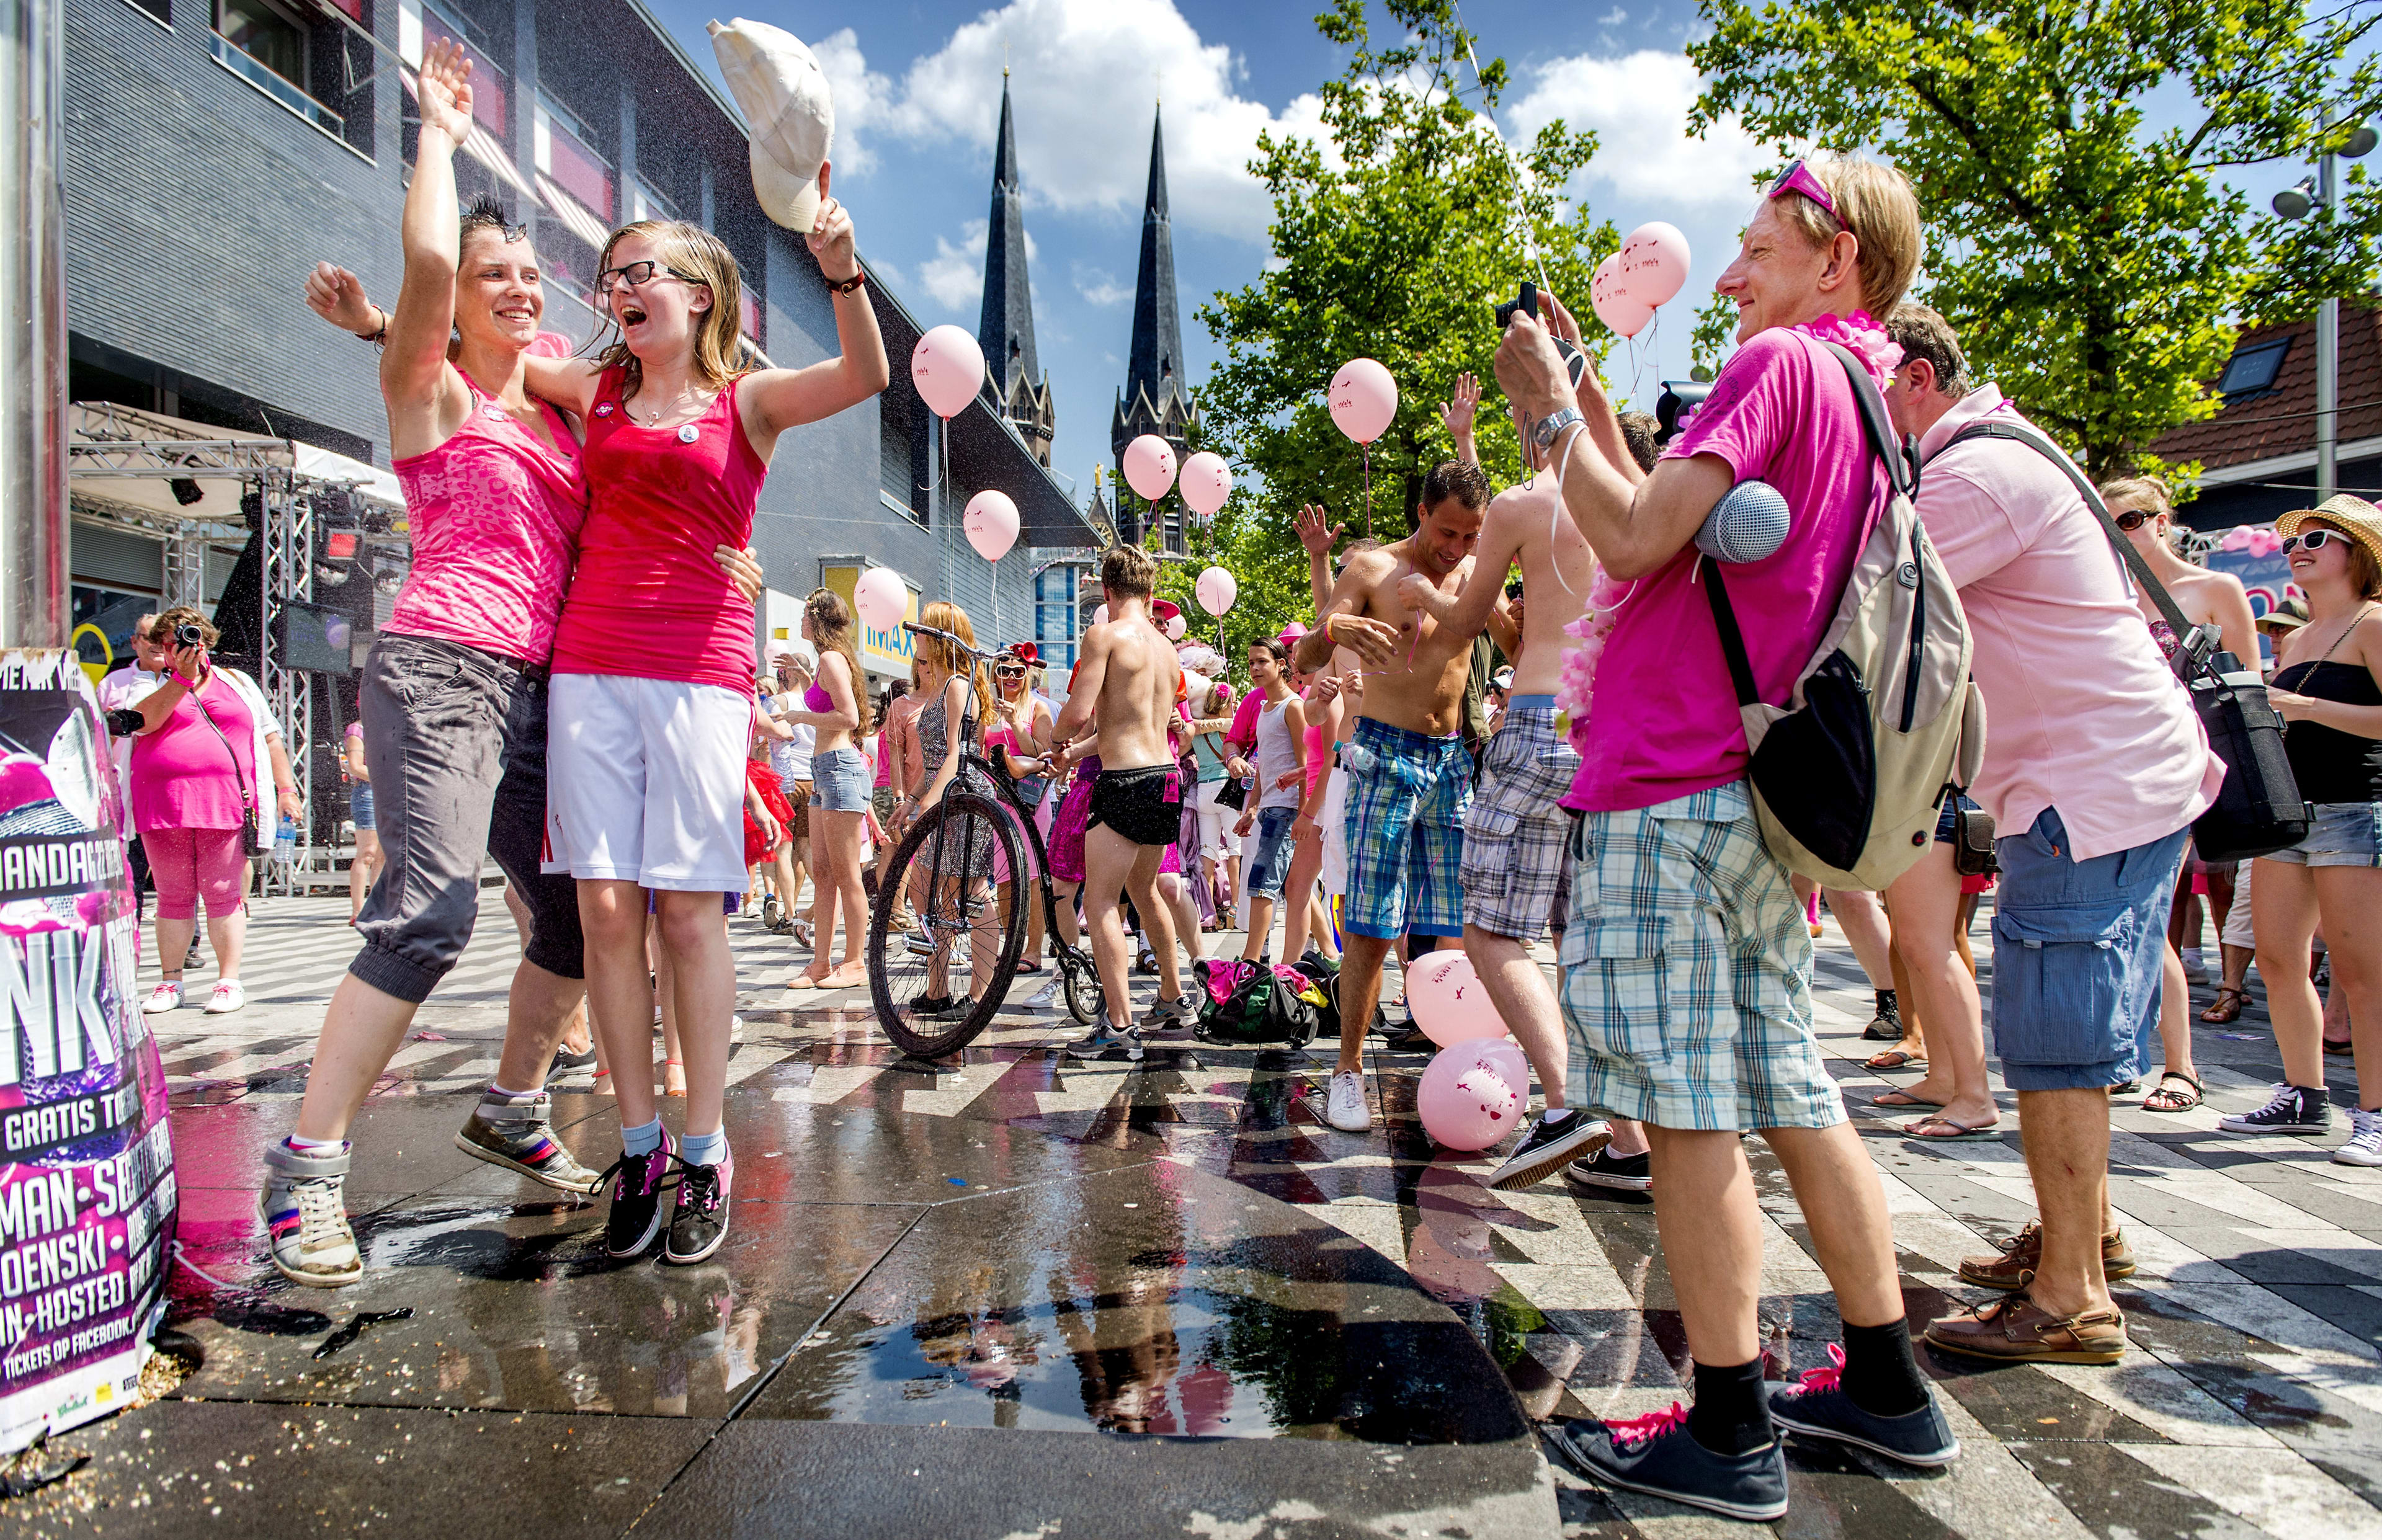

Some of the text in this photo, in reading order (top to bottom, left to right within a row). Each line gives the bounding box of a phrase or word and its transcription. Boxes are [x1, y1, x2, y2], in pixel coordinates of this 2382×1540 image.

[867, 624, 914, 659] IMAX
[0, 840, 97, 892] ANDAG
[5, 1098, 96, 1152] GRATIS
[35, 1270, 125, 1333] HOSTED
[3, 1344, 52, 1380] TICKETS
[53, 1337, 71, 1362] OP
